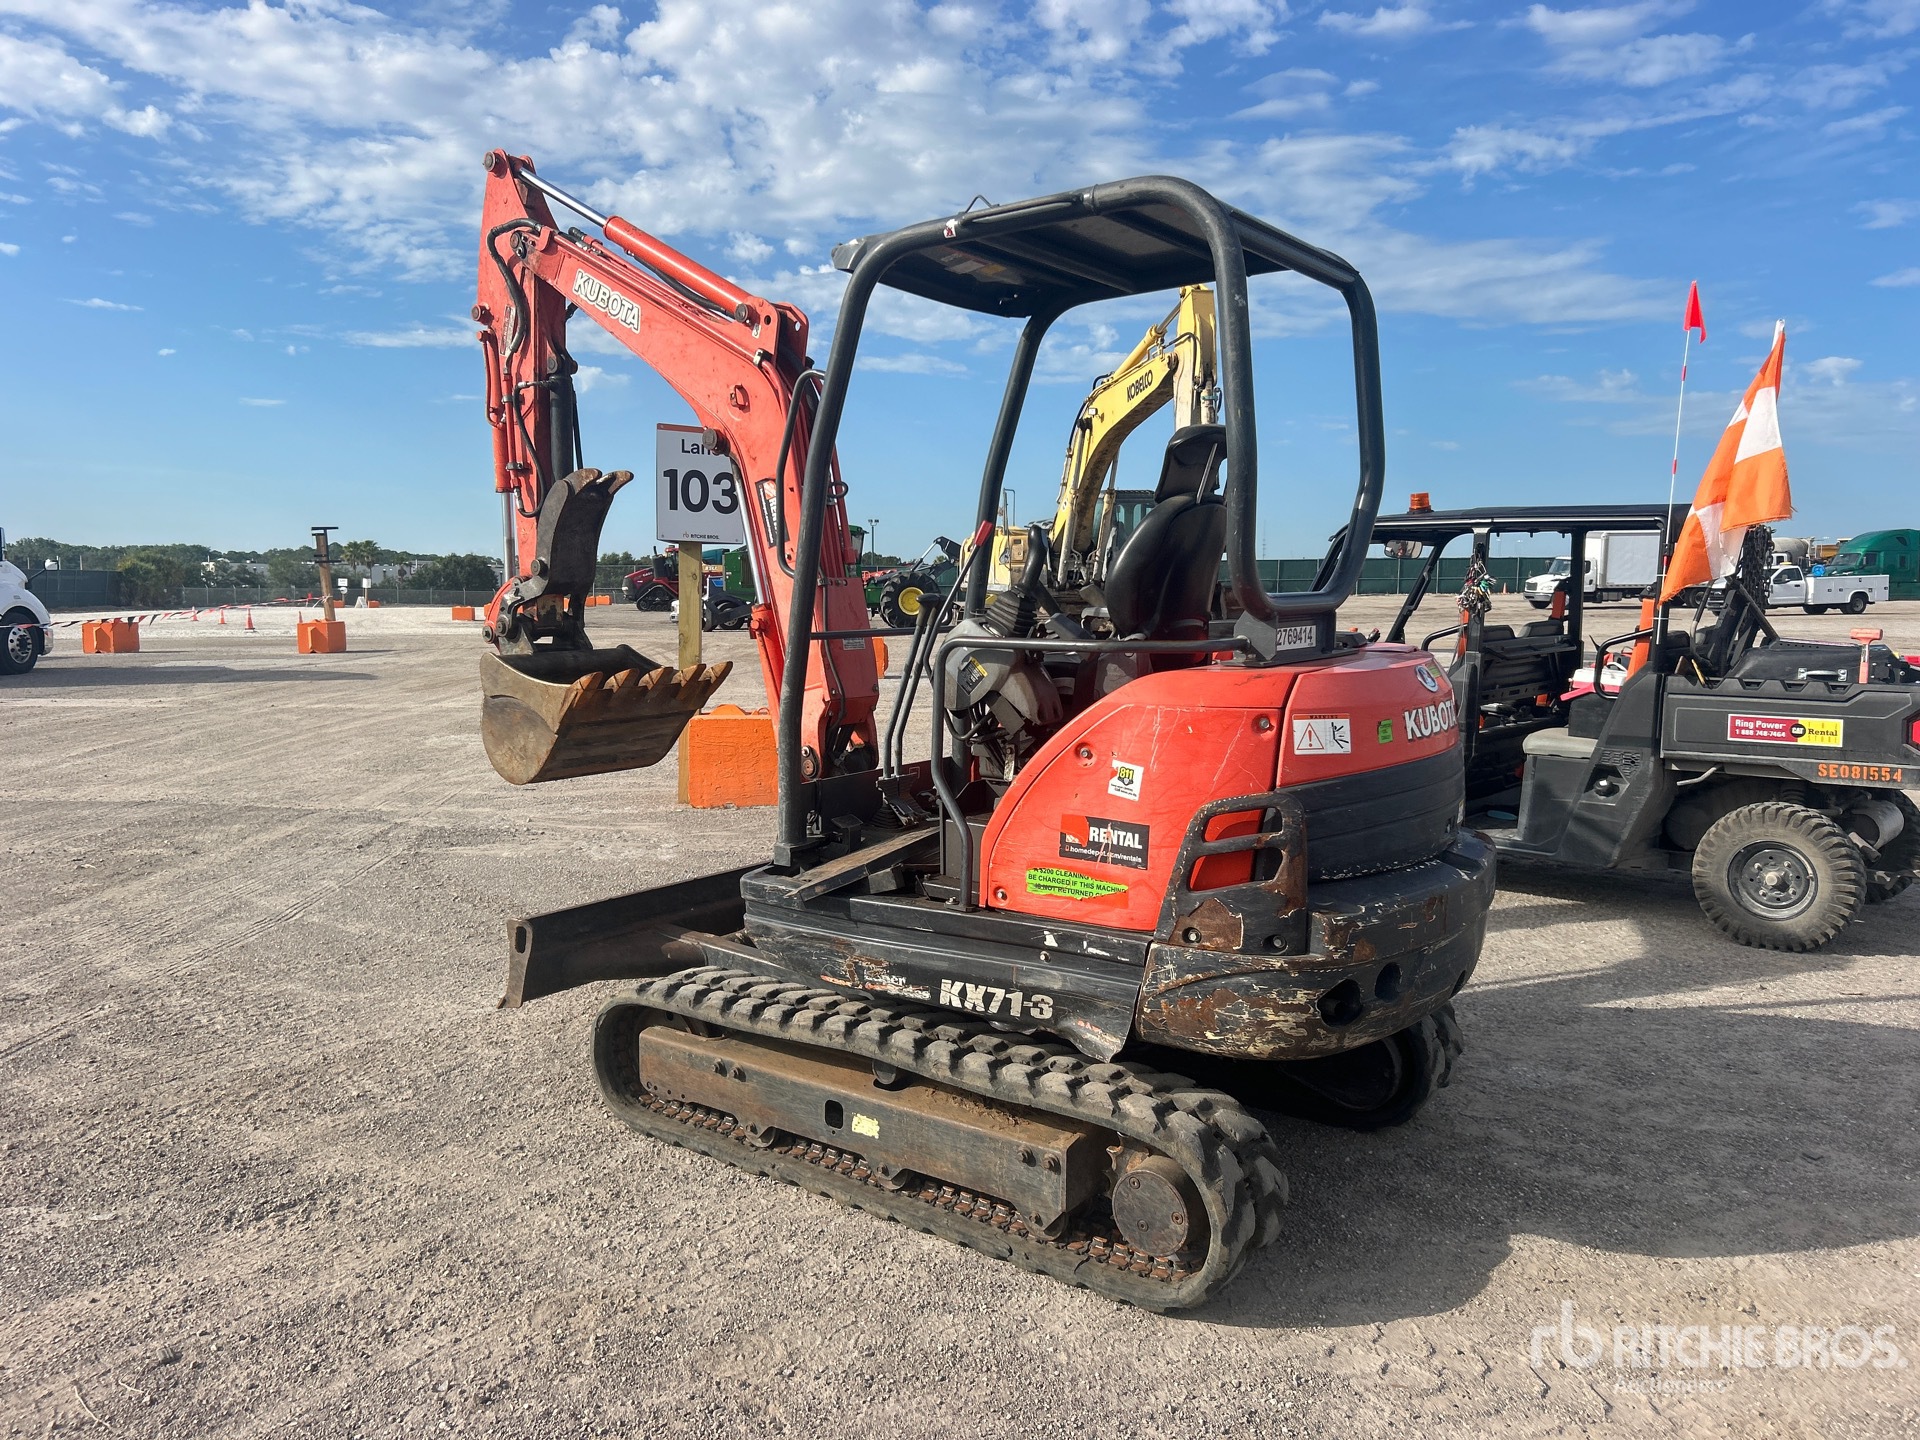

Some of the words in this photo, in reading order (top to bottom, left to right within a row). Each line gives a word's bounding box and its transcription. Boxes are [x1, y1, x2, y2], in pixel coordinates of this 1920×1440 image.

[573, 269, 640, 332] KUBOTA
[1127, 369, 1154, 402] KOBELCO
[681, 438, 721, 456] Lan
[663, 468, 739, 514] 103
[1277, 626, 1313, 646] 2769414
[1404, 699, 1457, 740] KUBOTA
[1735, 719, 1754, 730] Ring
[1808, 728, 1838, 737] Rental
[1119, 766, 1134, 781] 811
[1818, 763, 1902, 782] SE081554
[1088, 826, 1143, 850] RENTAL
[1028, 873, 1038, 881] BE
[1038, 875, 1071, 887] CHARGED
[1080, 881, 1095, 890] THIS
[1058, 887, 1094, 898] RETURNED
[939, 979, 1054, 1020] KX71-3
